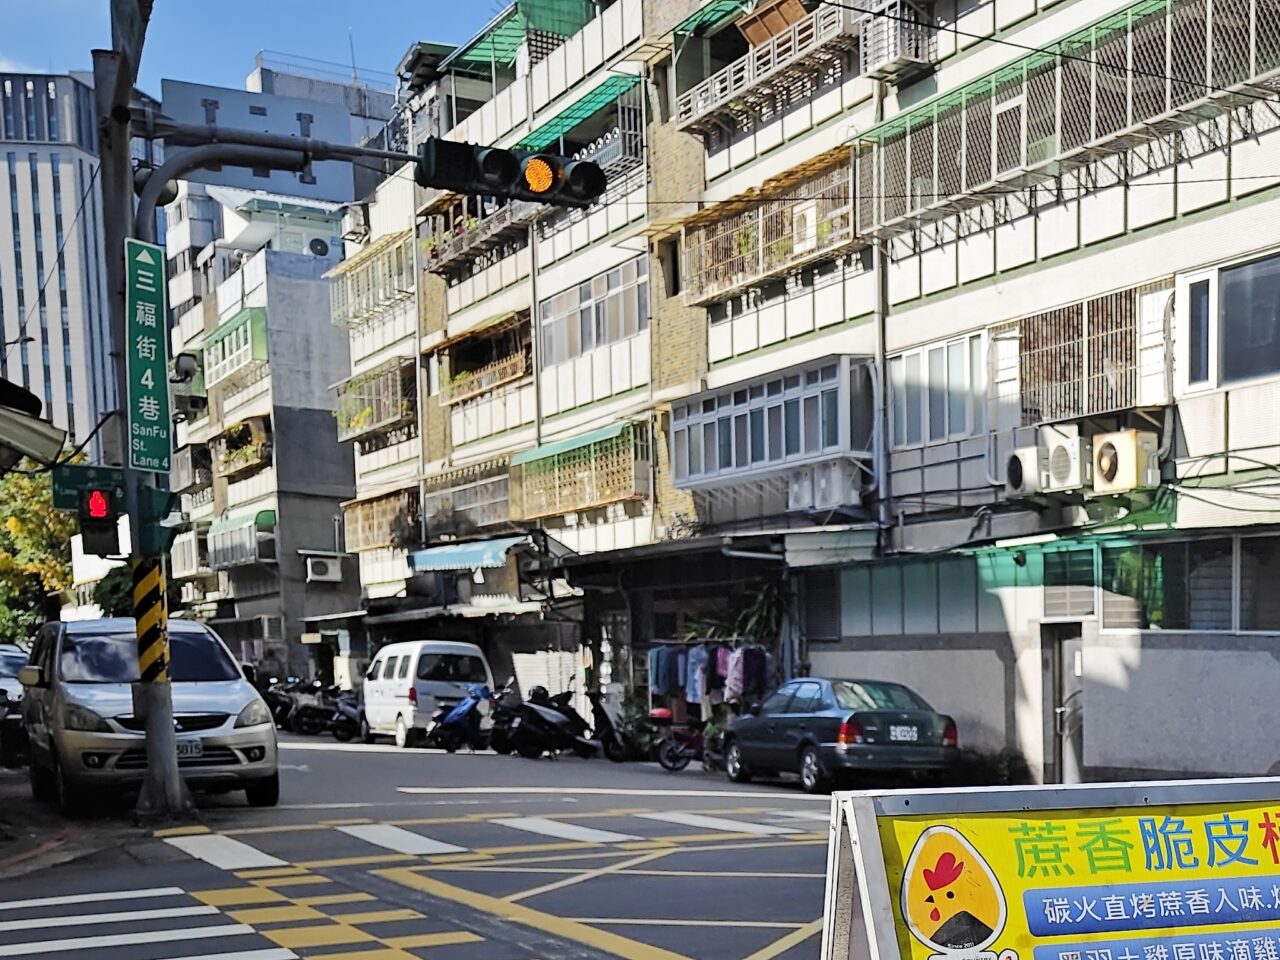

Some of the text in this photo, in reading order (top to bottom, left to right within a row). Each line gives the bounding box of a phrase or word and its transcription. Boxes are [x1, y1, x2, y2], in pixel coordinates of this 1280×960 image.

[135, 269, 160, 421] 三福街4巷
[132, 422, 167, 439] SanFu
[132, 439, 147, 451] St.
[133, 453, 169, 468] Lane 4
